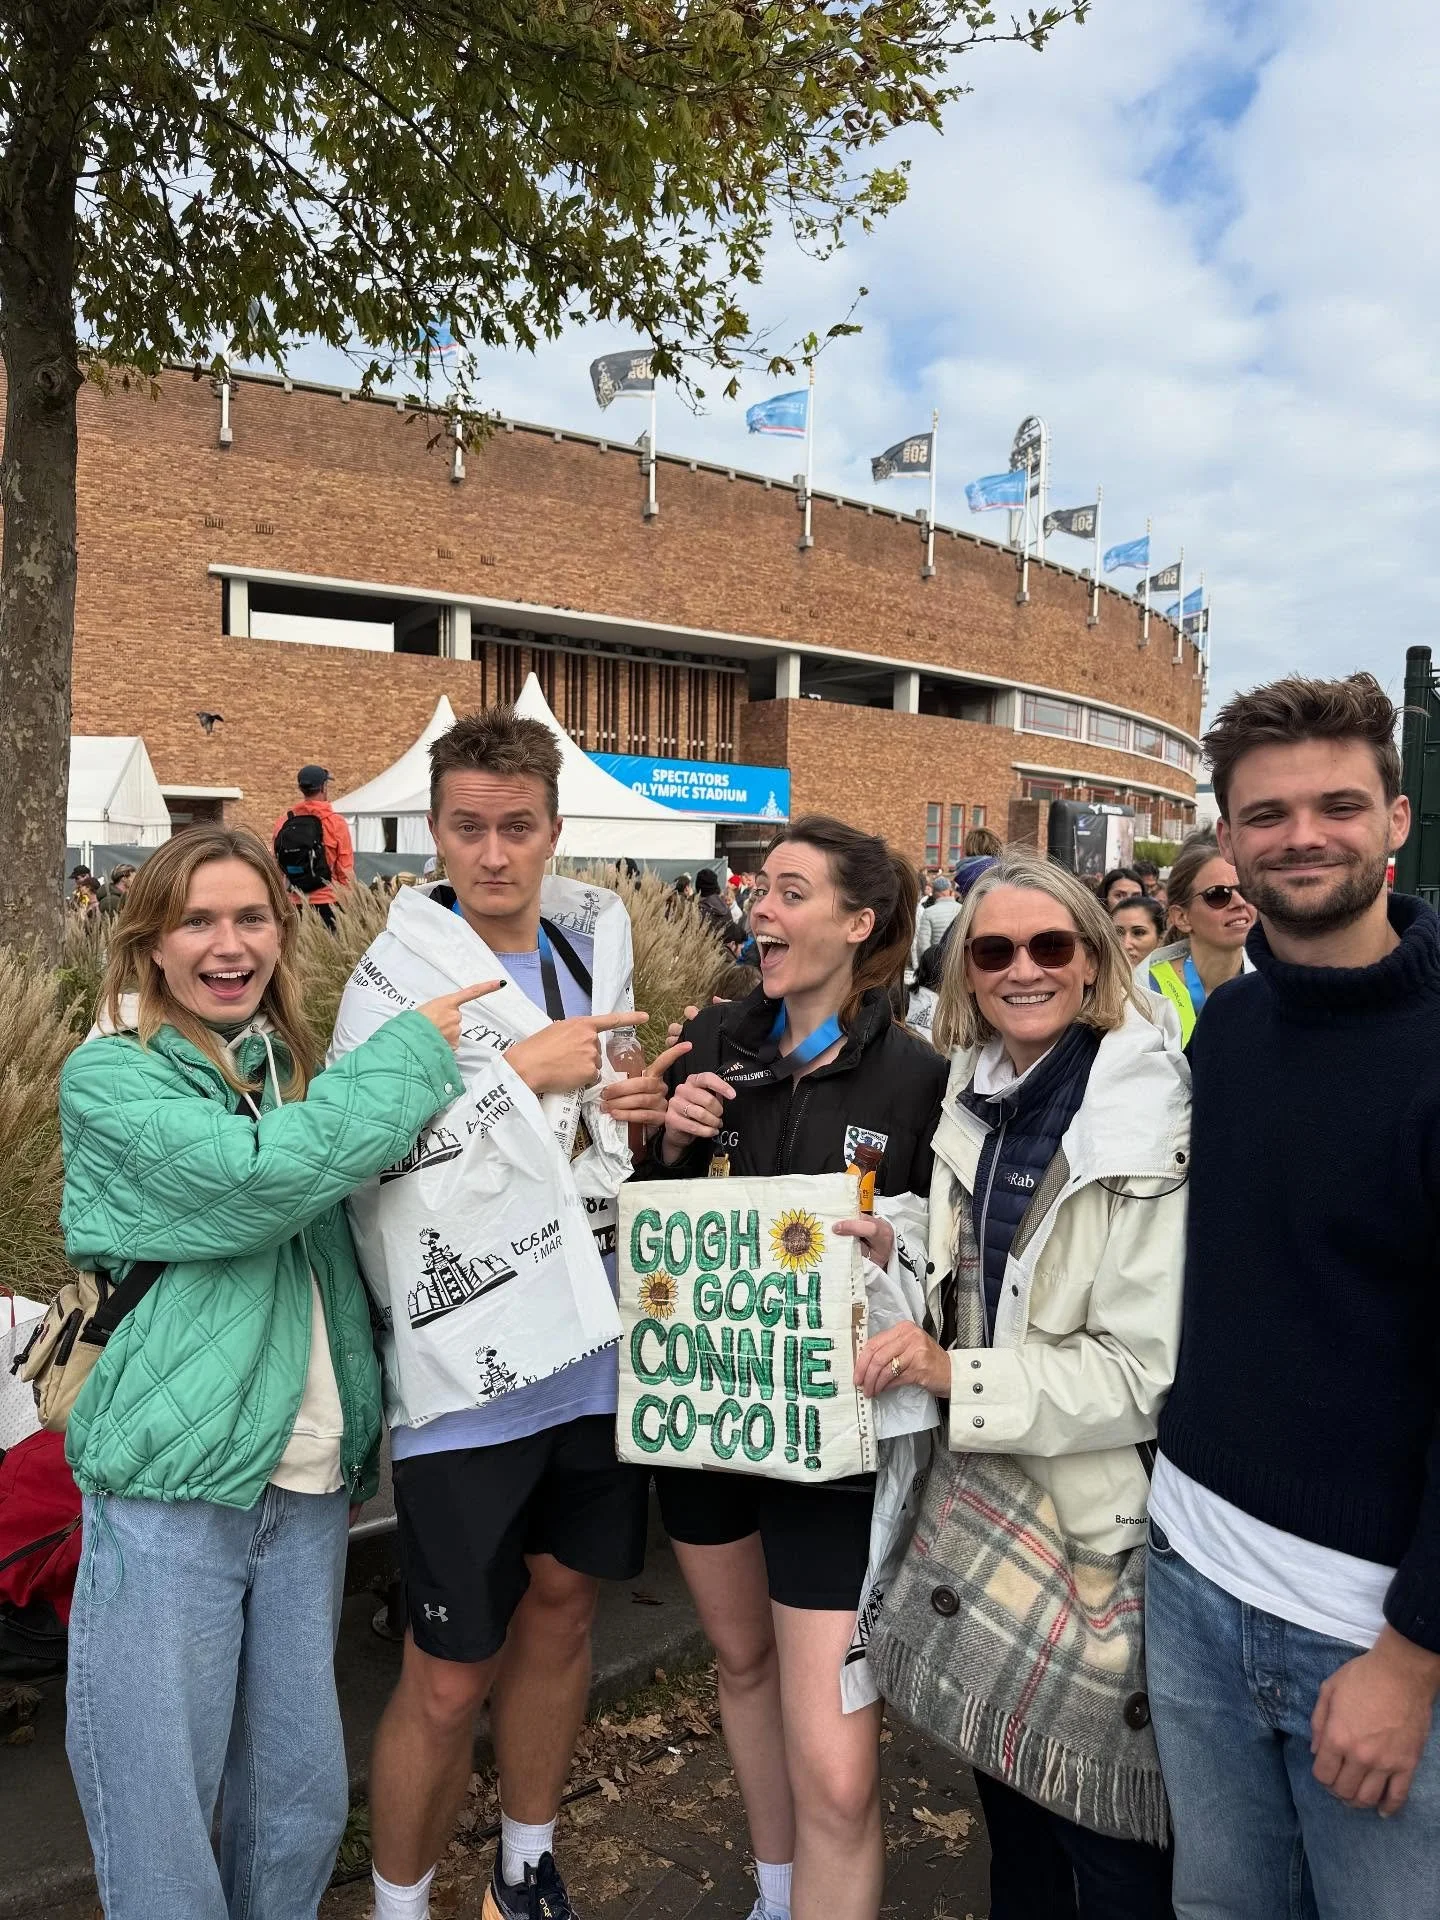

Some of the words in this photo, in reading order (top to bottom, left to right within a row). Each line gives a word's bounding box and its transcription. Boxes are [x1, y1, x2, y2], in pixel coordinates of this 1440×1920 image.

[652, 769, 730, 787] SPECTATORS
[632, 782, 690, 799] OLYMPIC
[692, 787, 748, 802] STADIUM
[1009, 1172, 1035, 1188] Rab
[630, 1207, 761, 1276] GOGH
[693, 1269, 823, 1330] GOGH
[630, 1317, 839, 1401] CONNIE
[1115, 1513, 1148, 1525] Barbour
